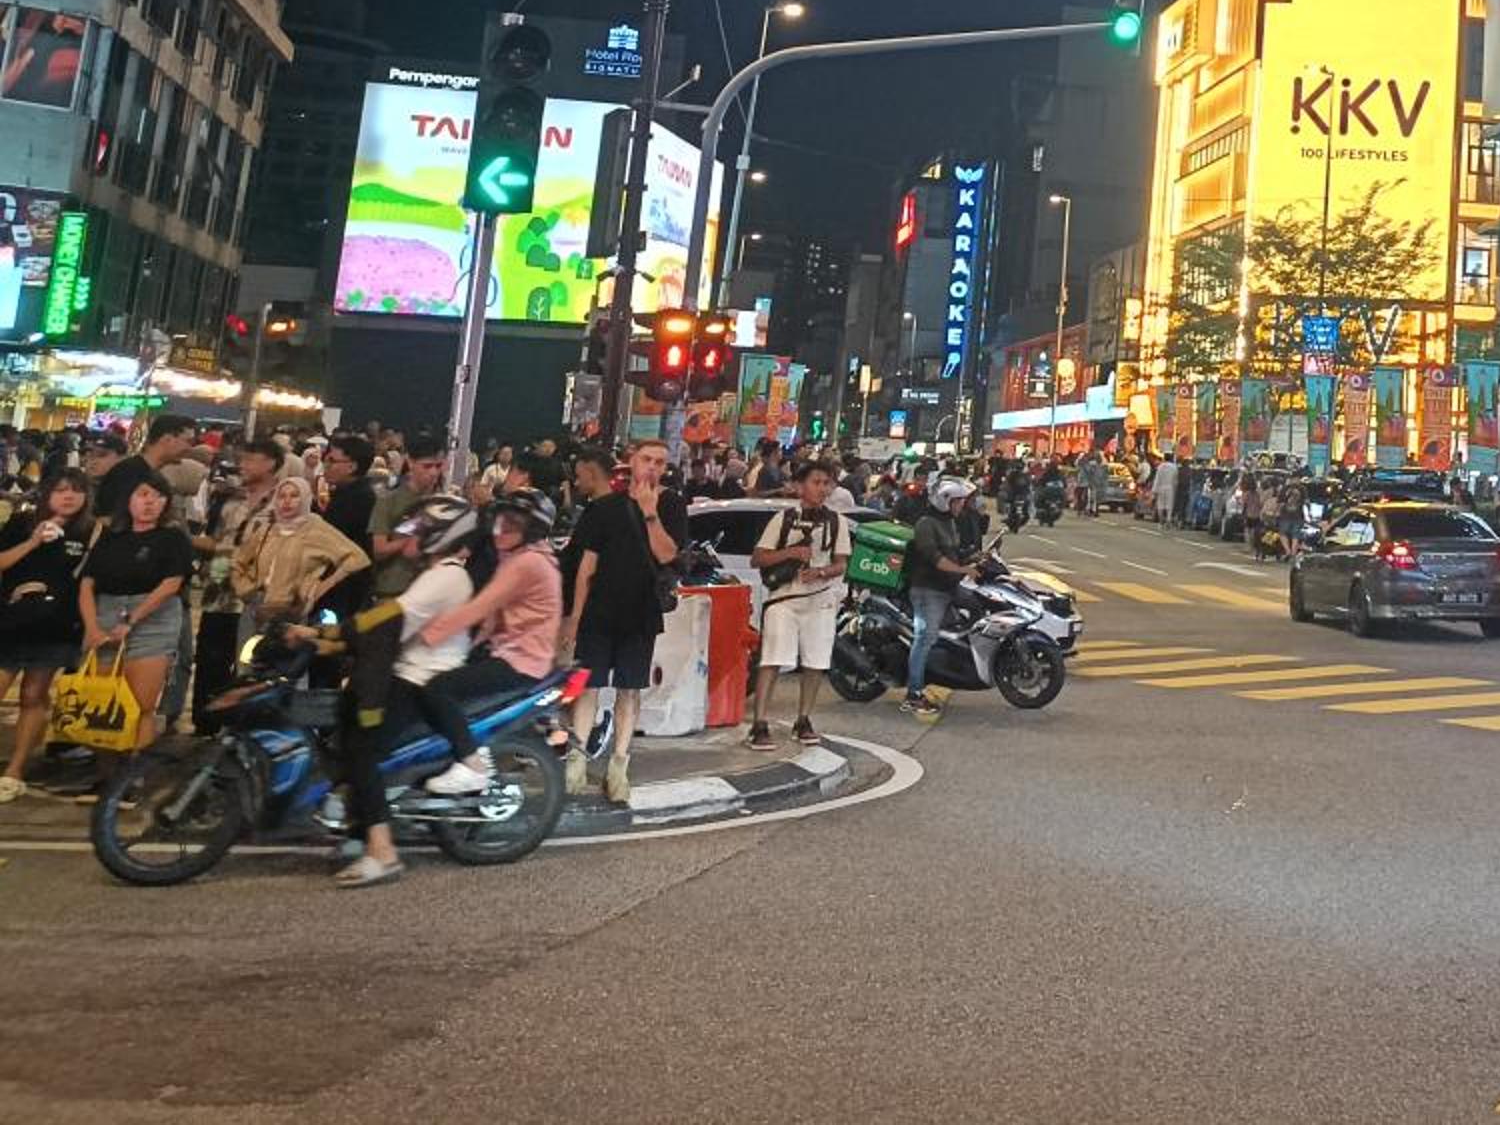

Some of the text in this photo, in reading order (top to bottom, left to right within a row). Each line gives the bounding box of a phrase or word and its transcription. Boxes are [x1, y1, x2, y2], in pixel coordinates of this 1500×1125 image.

[585, 63, 640, 75] SIGNATU
[1290, 77, 1431, 137] KKV
[411, 114, 572, 149] TAIN
[1301, 147, 1408, 162] 100 LIFESTYLES
[946, 188, 976, 345] KARAOKE
[859, 558, 889, 575] Grab
